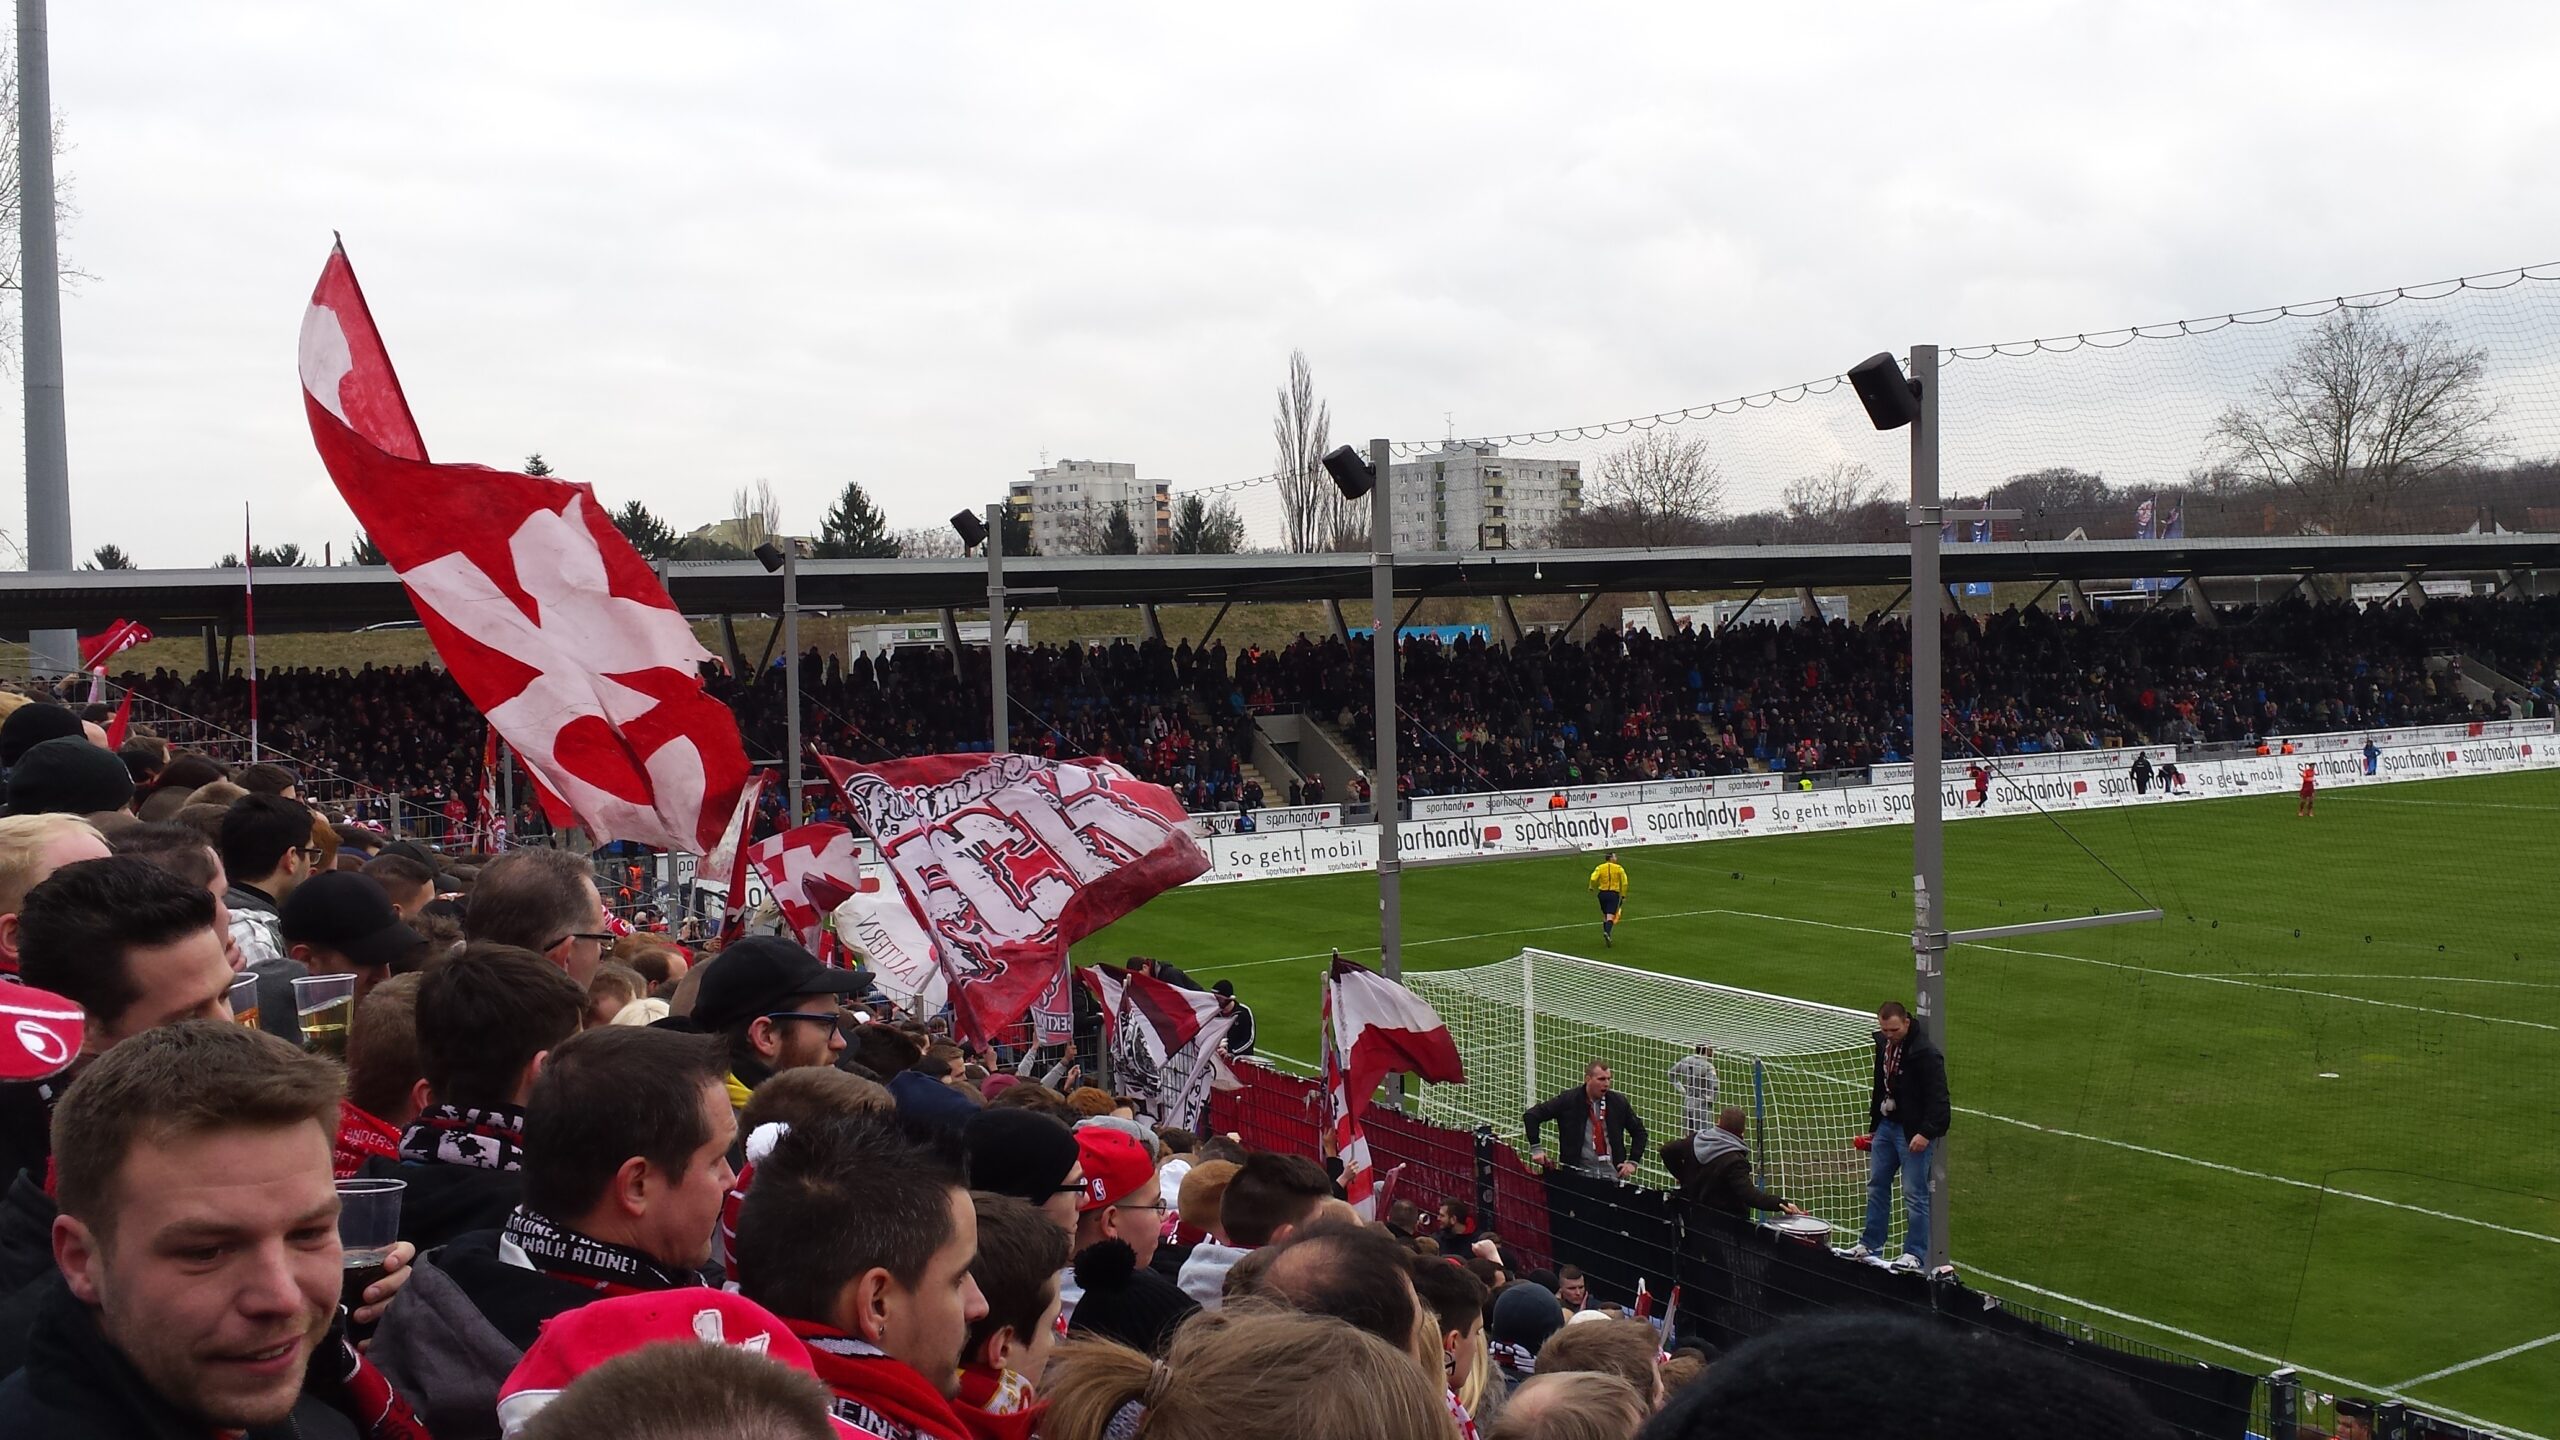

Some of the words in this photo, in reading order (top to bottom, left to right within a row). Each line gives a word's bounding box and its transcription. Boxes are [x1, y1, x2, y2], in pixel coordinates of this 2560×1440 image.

[2384, 747, 2446, 771] sparhandy
[2462, 741, 2520, 766] sparhandy
[1884, 768, 1913, 780] sparhand
[2199, 774, 2213, 786] So
[1670, 782, 1706, 795] sparhandy
[1997, 776, 2072, 804] sparhandy
[1266, 809, 1319, 828] sparhandy
[1426, 801, 1468, 814] sparhandy
[1647, 801, 1737, 833] sparhandy
[1772, 807, 1789, 821] So
[1796, 803, 1828, 822] geht
[1835, 799, 1876, 816] mobil
[1515, 812, 1608, 845] sparhandy
[1230, 850, 1252, 866] So
[1260, 846, 1302, 868] geht
[1311, 840, 1362, 859] mobil
[521, 1236, 567, 1259] WALK
[571, 1246, 637, 1275] ALONE!
